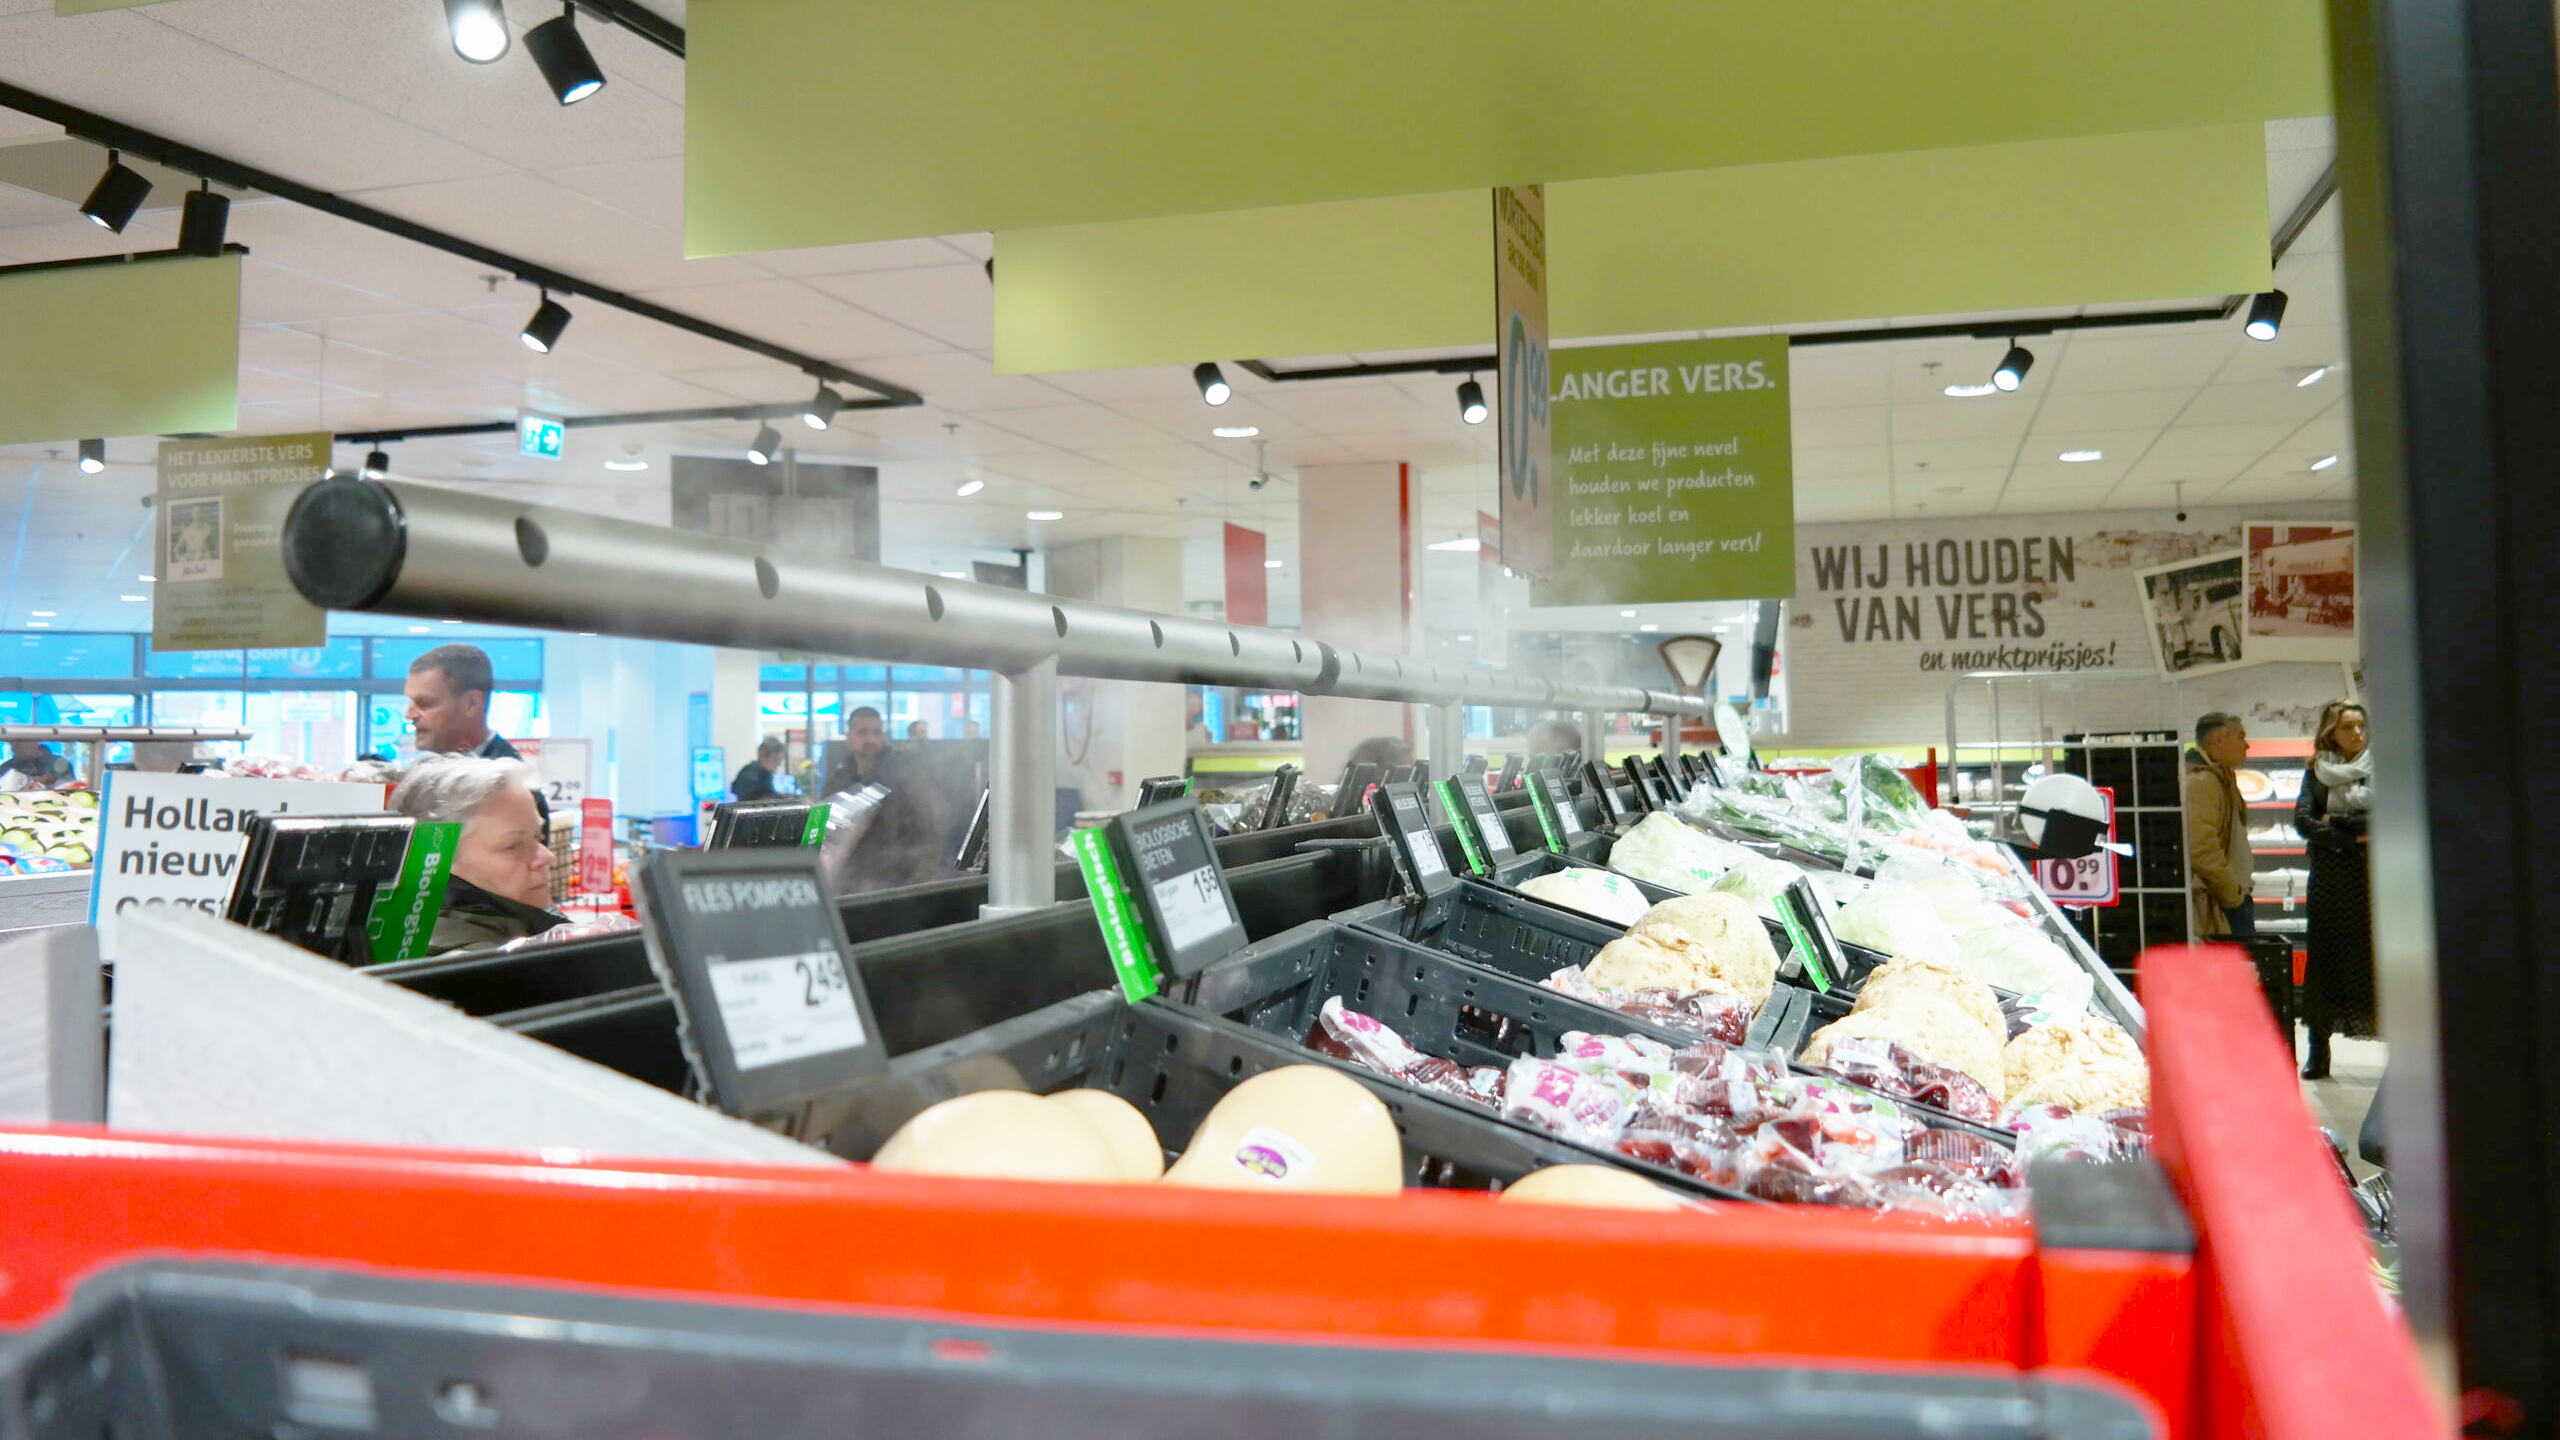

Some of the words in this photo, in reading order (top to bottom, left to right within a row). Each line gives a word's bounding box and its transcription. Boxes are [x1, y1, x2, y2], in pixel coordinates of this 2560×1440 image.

[1550, 368, 1670, 401] ANGER
[1678, 361, 1775, 394] VERS.
[168, 451, 194, 467] HET
[200, 446, 275, 465] LEKKERSTE
[278, 443, 314, 461] VERS
[1568, 444, 1600, 465] Met
[1607, 442, 1645, 462] deze
[1650, 441, 1687, 468] fijne
[1694, 437, 1738, 457] nevel
[167, 471, 209, 487] VOOR
[211, 465, 320, 485] MARKTPRIJSJES
[1568, 474, 1631, 495] houden
[1638, 477, 1659, 491] we
[1667, 468, 1755, 498] producten
[1570, 508, 1621, 527] lekker
[1628, 505, 1662, 525] koel
[1669, 511, 1688, 522] en
[1571, 537, 1651, 558] daardoor
[1658, 536, 1713, 562] langer
[1720, 531, 1762, 553] vers!
[1811, 544, 1889, 591] WIJ
[1905, 536, 2076, 588] HOUDEN
[1835, 595, 1921, 643] VAN
[1936, 592, 2046, 640] VERS
[1920, 650, 1945, 671] en
[1951, 641, 2116, 672] marktprijsjes!
[1135, 819, 1193, 850] BIOLOGISCHE
[2050, 858, 2100, 891] 0.99
[397, 852, 443, 961] Biologisc
[682, 882, 735, 914] FLES
[732, 878, 820, 910] POMPOEN
